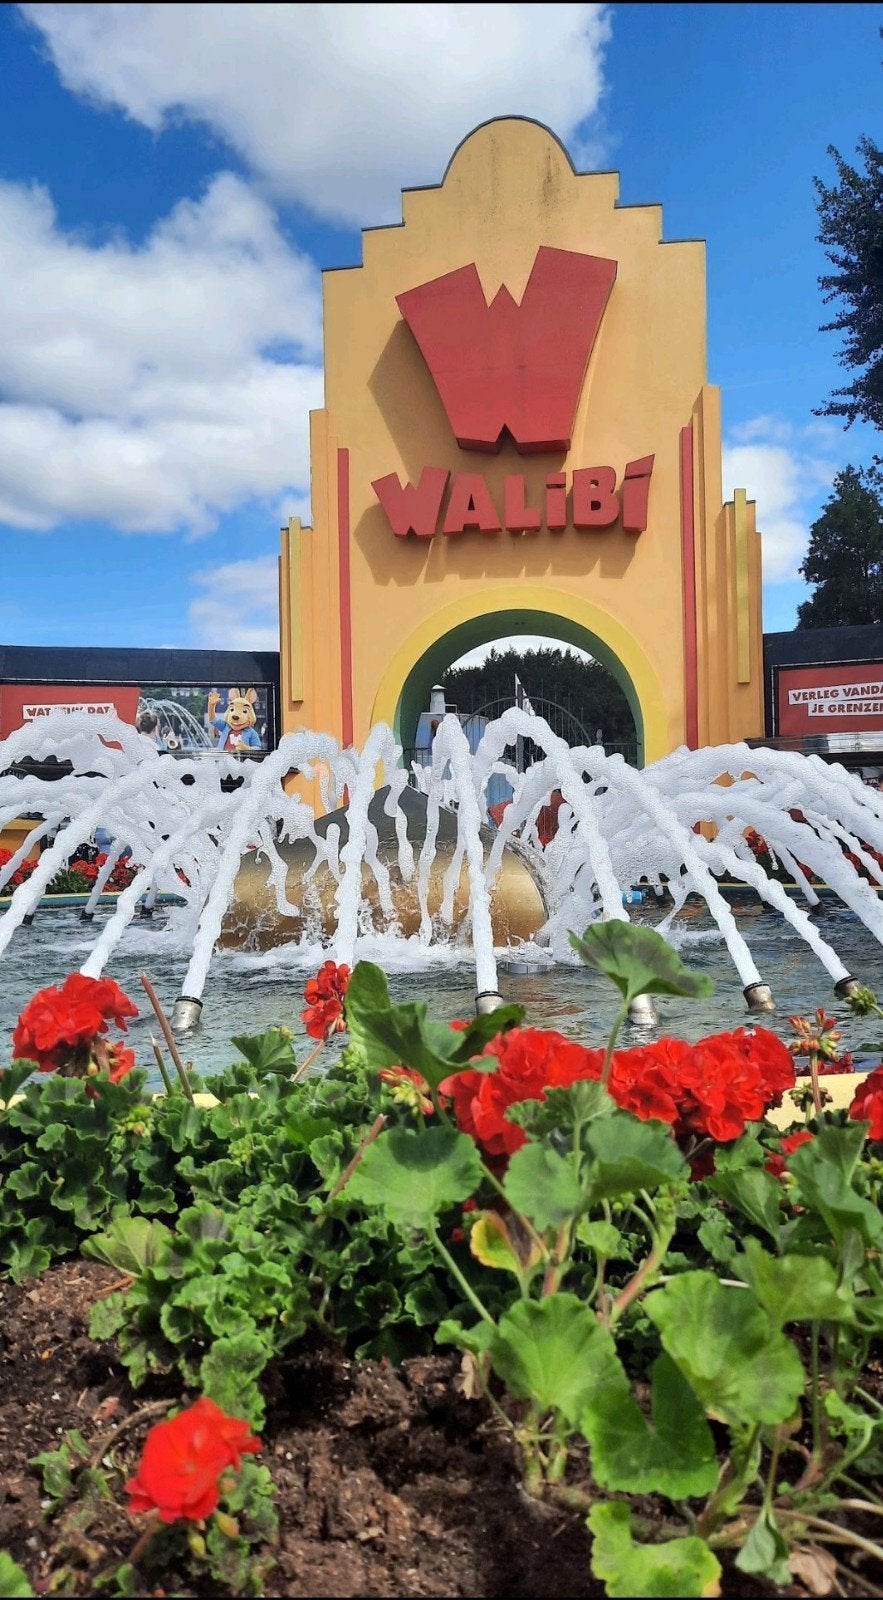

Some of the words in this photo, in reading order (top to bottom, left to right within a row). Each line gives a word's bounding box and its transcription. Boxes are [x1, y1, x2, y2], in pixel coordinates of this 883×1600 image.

[395, 246, 618, 454] W
[792, 689, 839, 701] VERLEG
[26, 707, 51, 717] WAT
[87, 706, 110, 714] DAT
